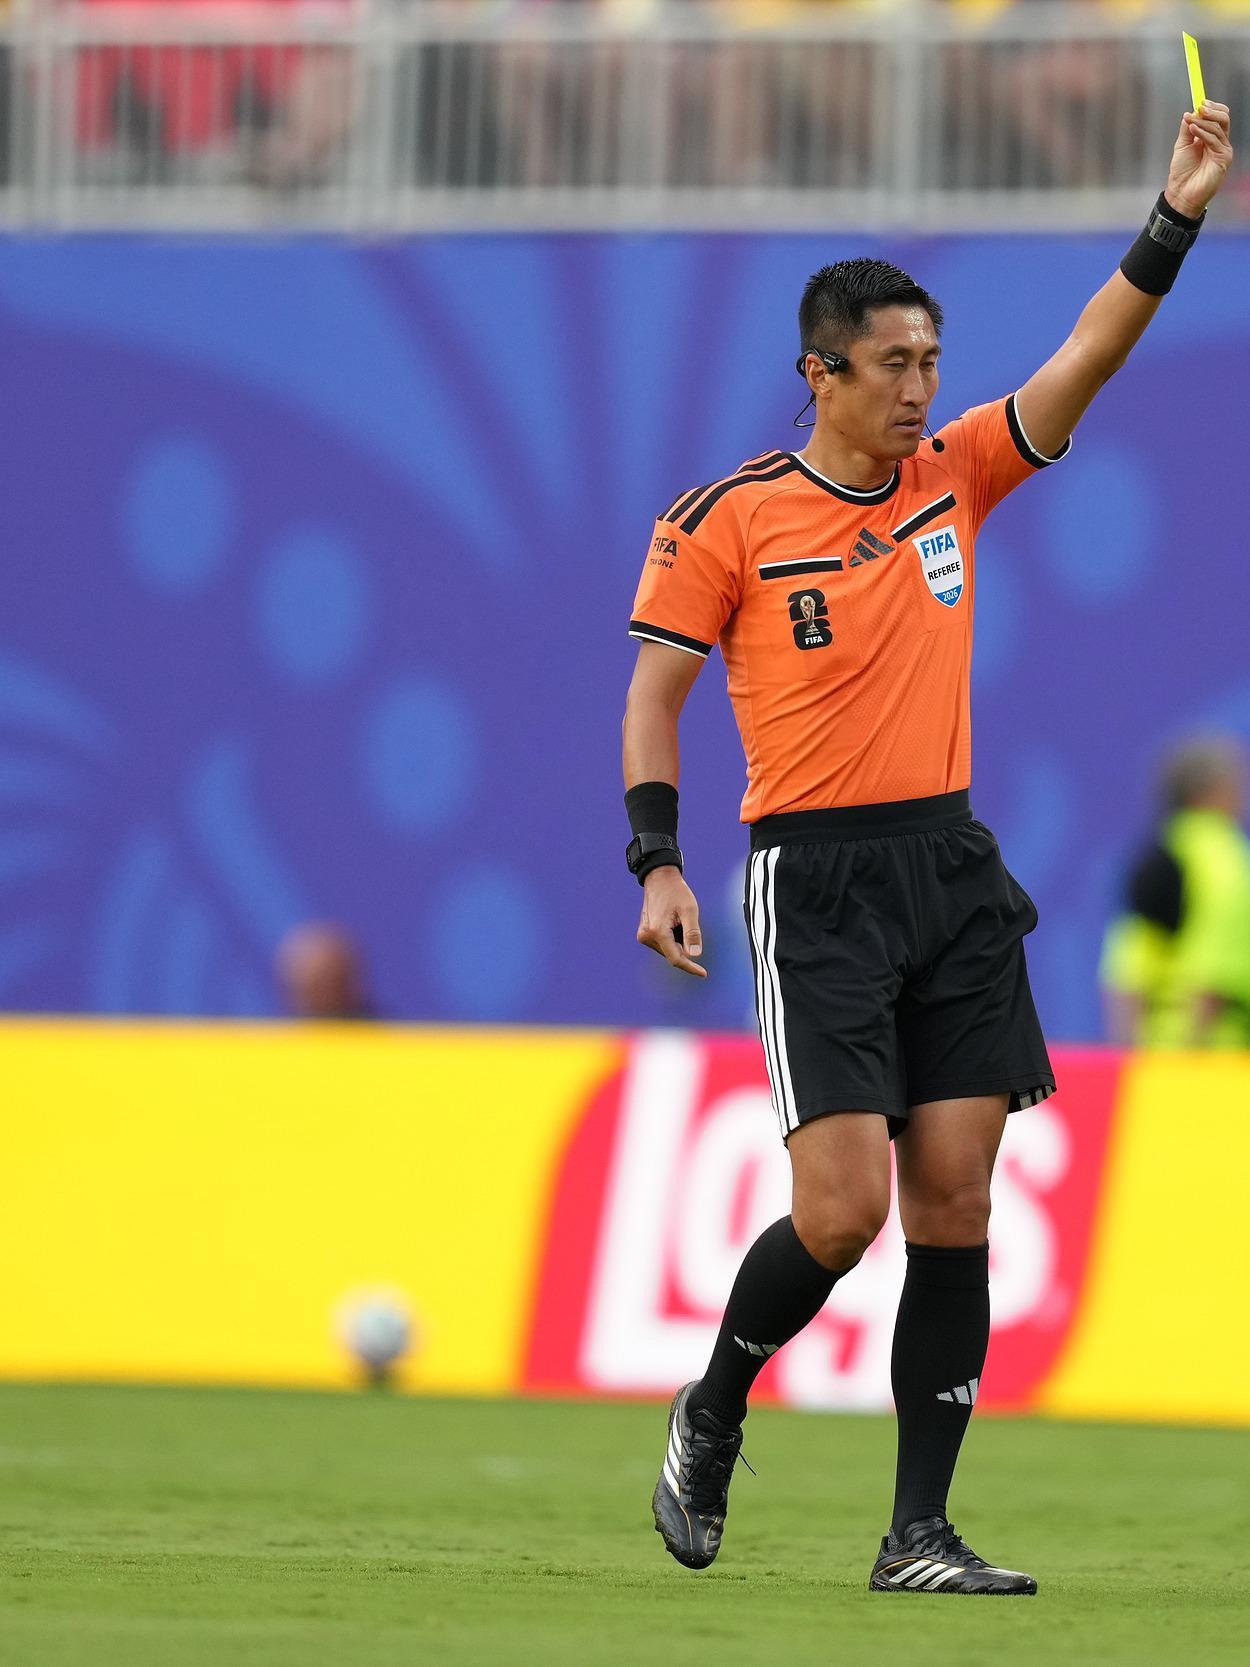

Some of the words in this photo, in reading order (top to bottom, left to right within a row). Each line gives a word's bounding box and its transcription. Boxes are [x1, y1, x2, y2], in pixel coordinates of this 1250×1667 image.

[920, 532, 955, 559] FIFA
[928, 561, 960, 581] REFEREE
[942, 588, 958, 602] 2026
[804, 635, 824, 645] FIFA
